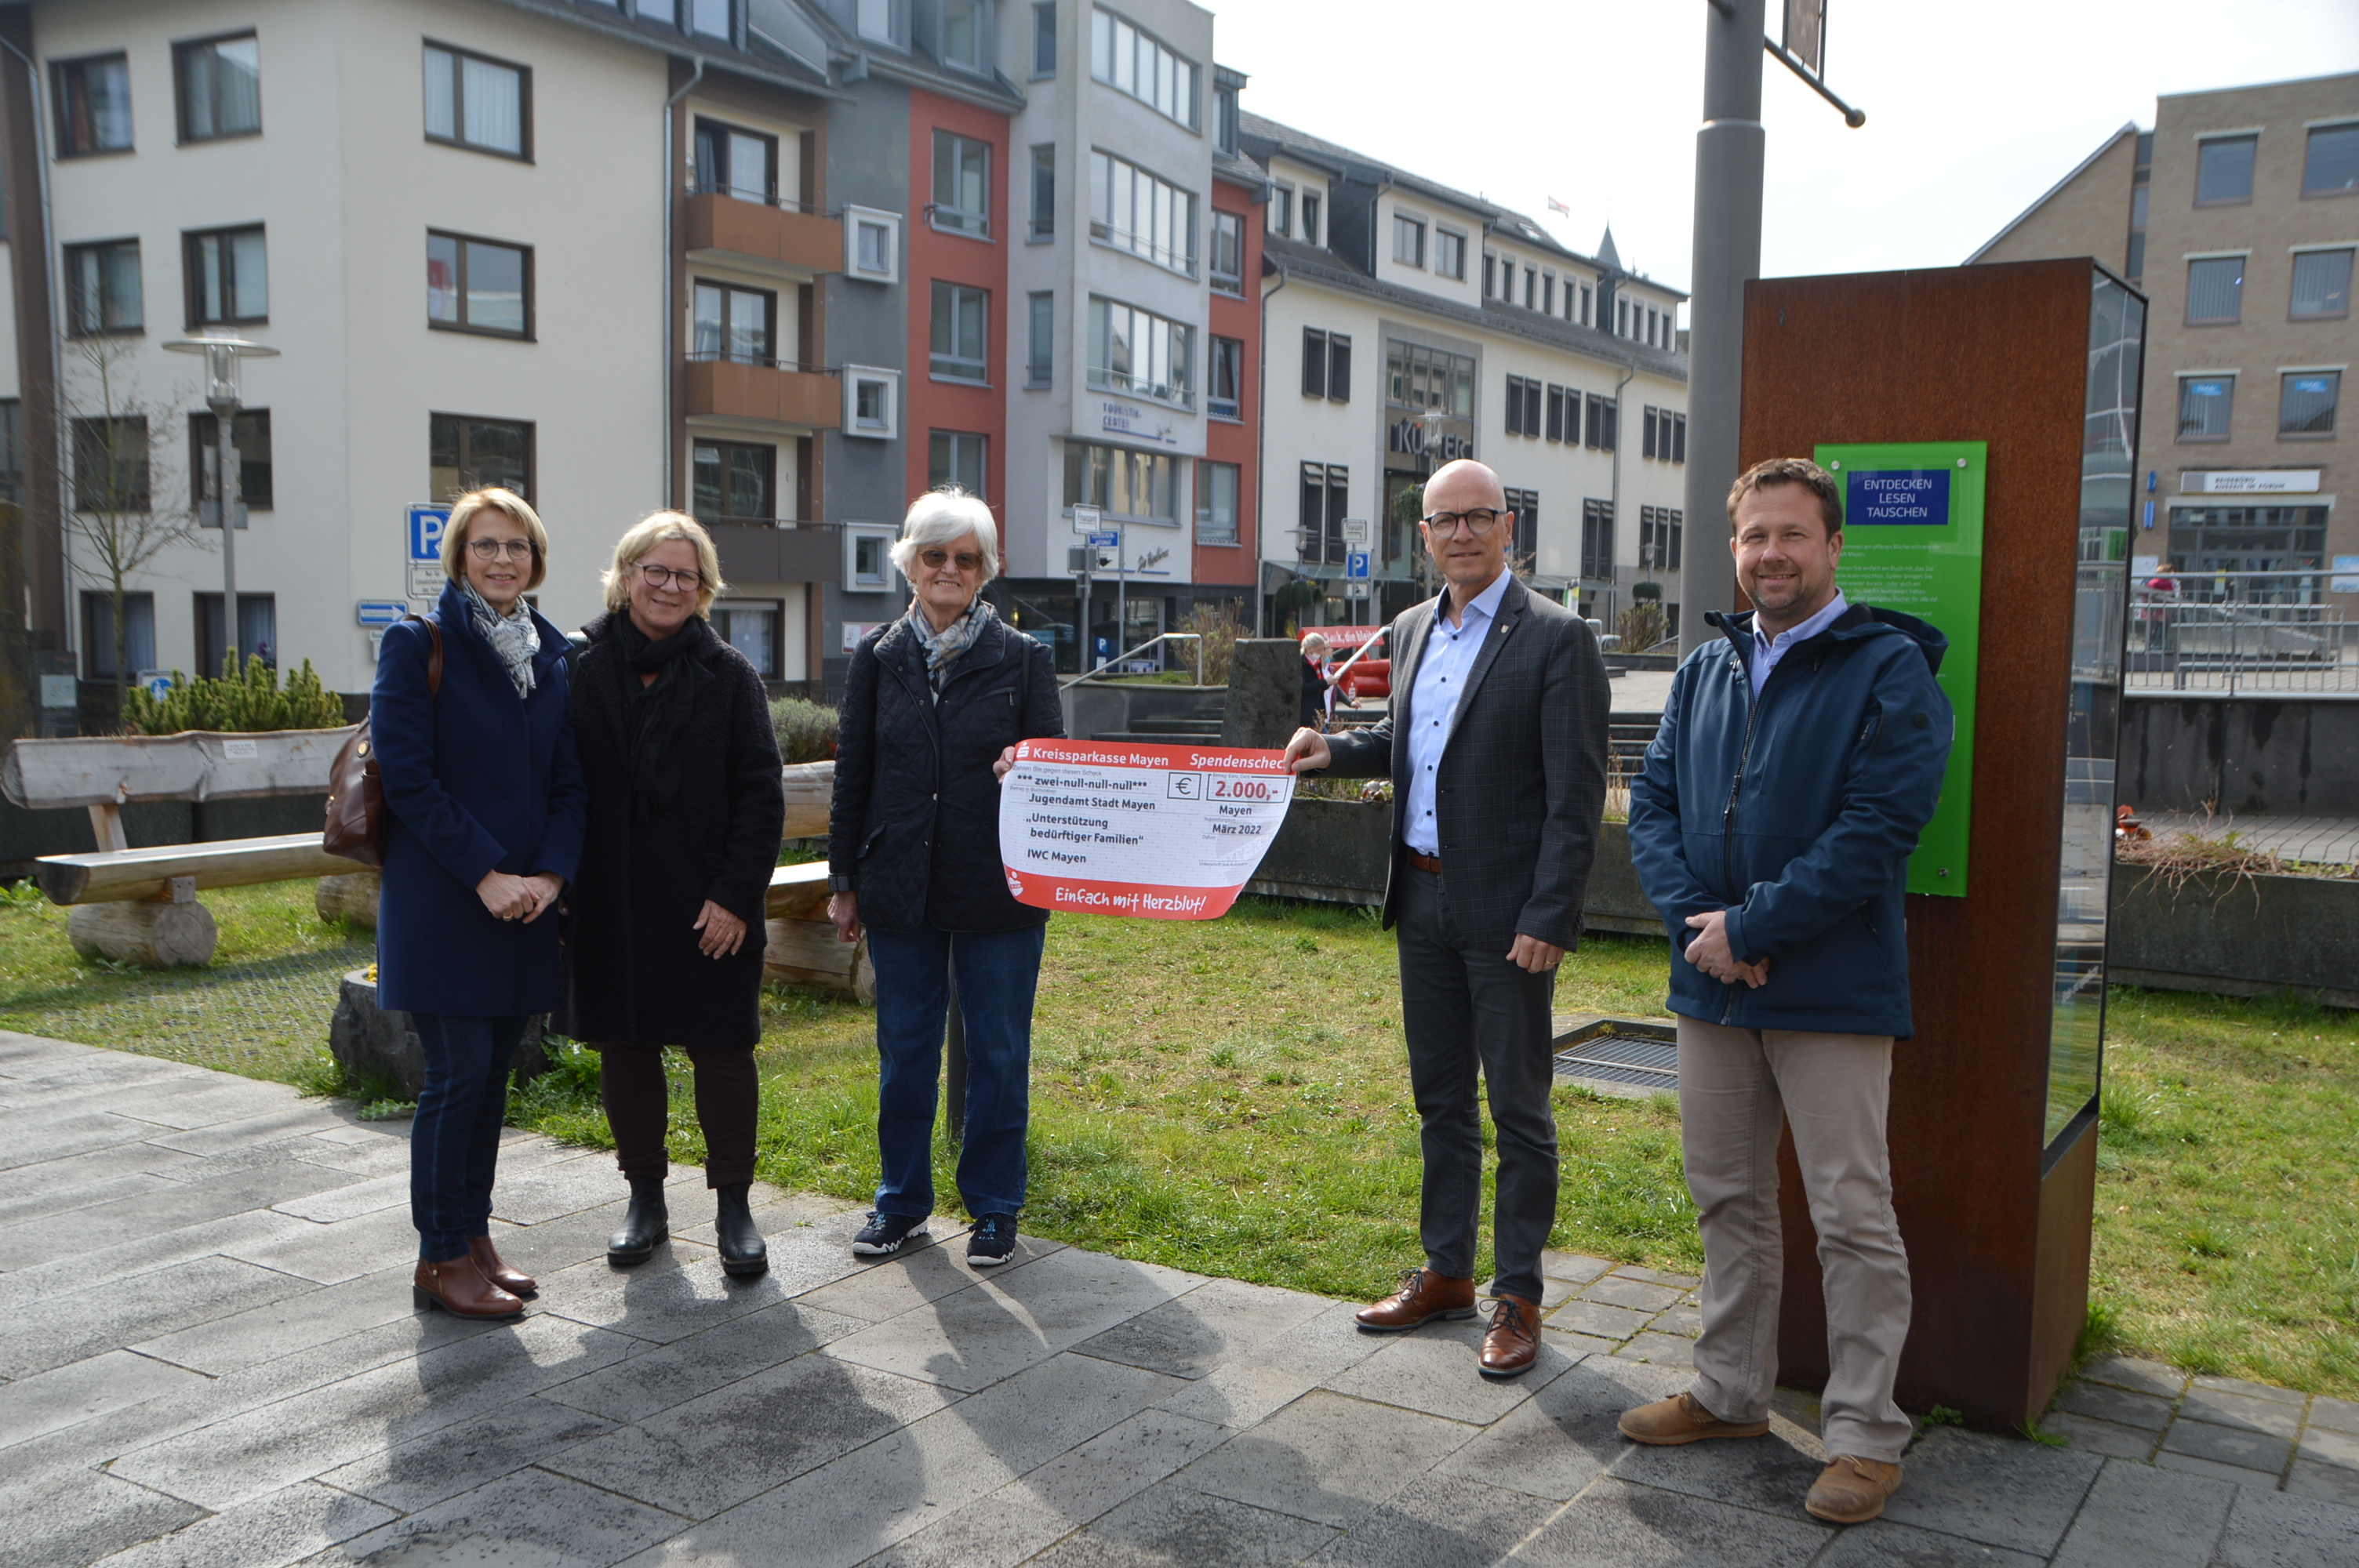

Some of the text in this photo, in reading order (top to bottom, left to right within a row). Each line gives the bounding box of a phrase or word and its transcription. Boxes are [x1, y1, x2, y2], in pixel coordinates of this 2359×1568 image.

[1864, 479, 1932, 491] ENTDECKEN
[1879, 493, 1916, 503] LESEN
[1866, 506, 1928, 517] TAUSCHEN
[420, 515, 444, 555] P
[1099, 638, 1107, 651] P
[1033, 747, 1127, 764] Kreissparkasse
[1129, 753, 1169, 768] Mayen
[1190, 753, 1286, 769] Spendenschec
[1176, 777, 1278, 801] € 2.000,-
[1029, 793, 1156, 811] Jugendamt Stadt Mayen
[1219, 804, 1252, 817] Mayen
[1030, 827, 1092, 844] bedürftiger
[1212, 823, 1262, 835] März 2022
[1027, 848, 1087, 864] IWC Mayen
[1055, 887, 1207, 916] Einfach mit Herzblut!
